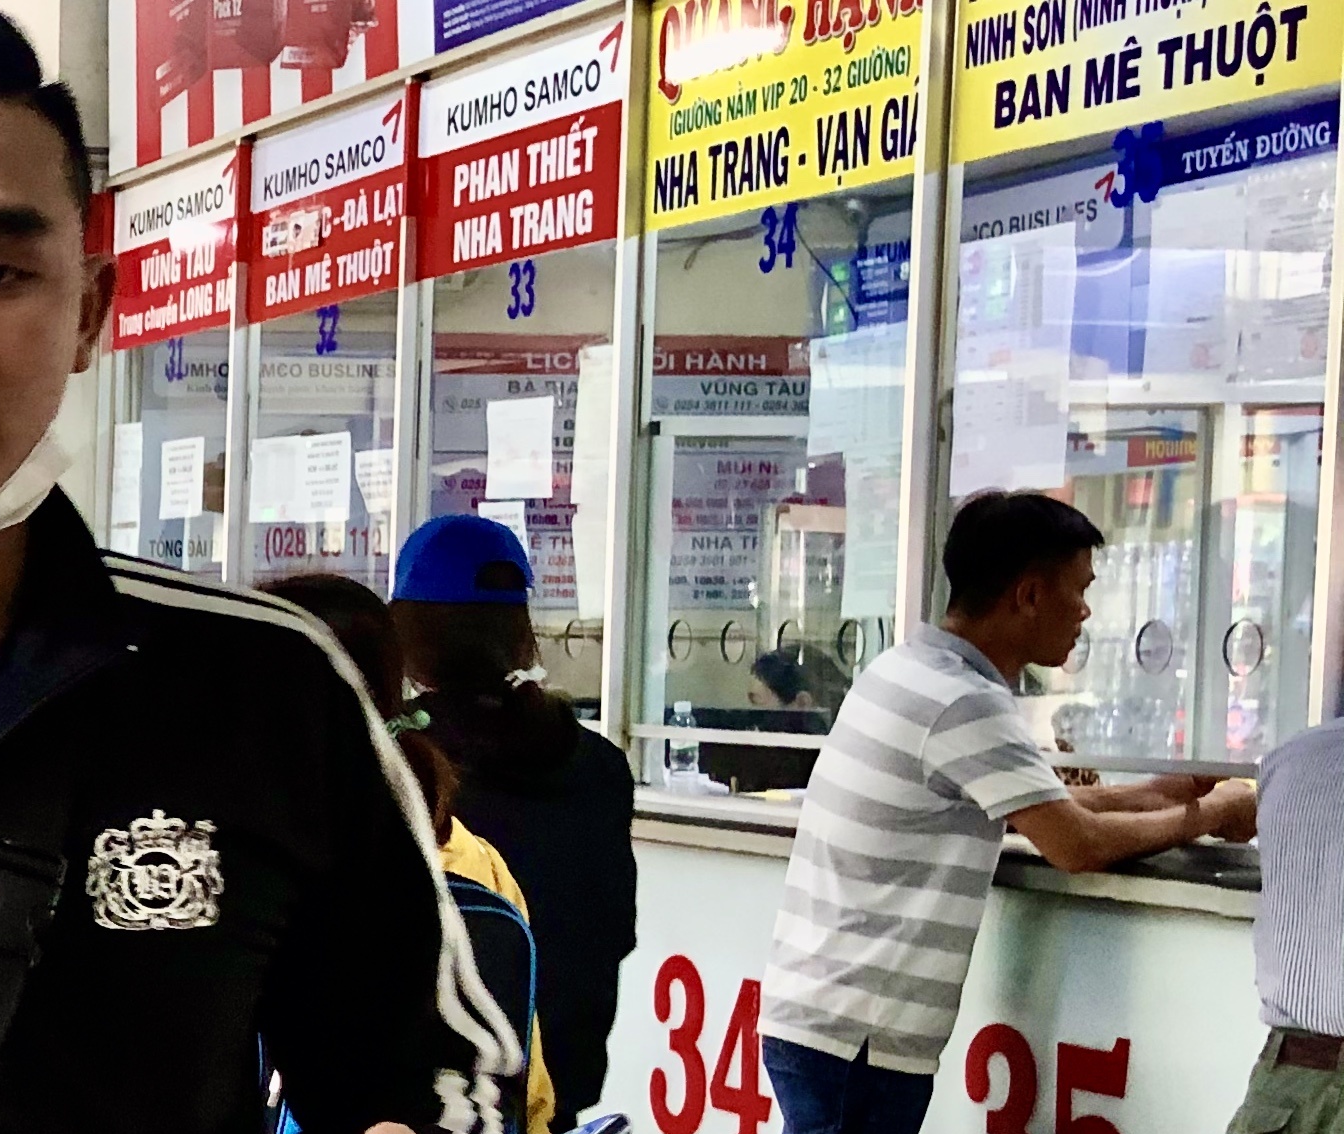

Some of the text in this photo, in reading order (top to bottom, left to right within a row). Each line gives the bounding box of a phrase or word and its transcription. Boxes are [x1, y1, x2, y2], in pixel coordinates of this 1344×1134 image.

[965, 10, 1017, 69] NINH
[994, 3, 1308, 130] BAN MÊ THUỘT
[446, 59, 601, 136] KUMHO SAMCO
[670, 96, 723, 140] (GIƯỜNG
[726, 81, 757, 122] NẰM
[762, 82, 785, 112] VIP
[789, 75, 808, 106] 20
[823, 64, 842, 96] 32
[847, 45, 912, 90] GIƯỜNG)
[264, 135, 386, 201] KUMHO SAMCO
[453, 116, 598, 208] PHAN THIẾT
[653, 150, 699, 214] NHA
[708, 126, 790, 201] TRANG
[797, 153, 807, 167] -
[816, 105, 872, 186] VẠN
[1181, 121, 1333, 175] TUYẾN ĐƯỜNG
[129, 184, 224, 239] KUMHO SAMCO
[453, 189, 594, 264] NHA TRANG
[759, 202, 799, 274] 34
[140, 249, 181, 293] VŨNG
[265, 239, 395, 307] BAN MÊ THUỘT
[506, 259, 537, 320] 33
[118, 312, 144, 338] Trung
[180, 282, 213, 323] LONG
[685, 350, 766, 371] HÀNH
[700, 377, 806, 396] VŨNG TÀU
[692, 536, 733, 551] NHA
